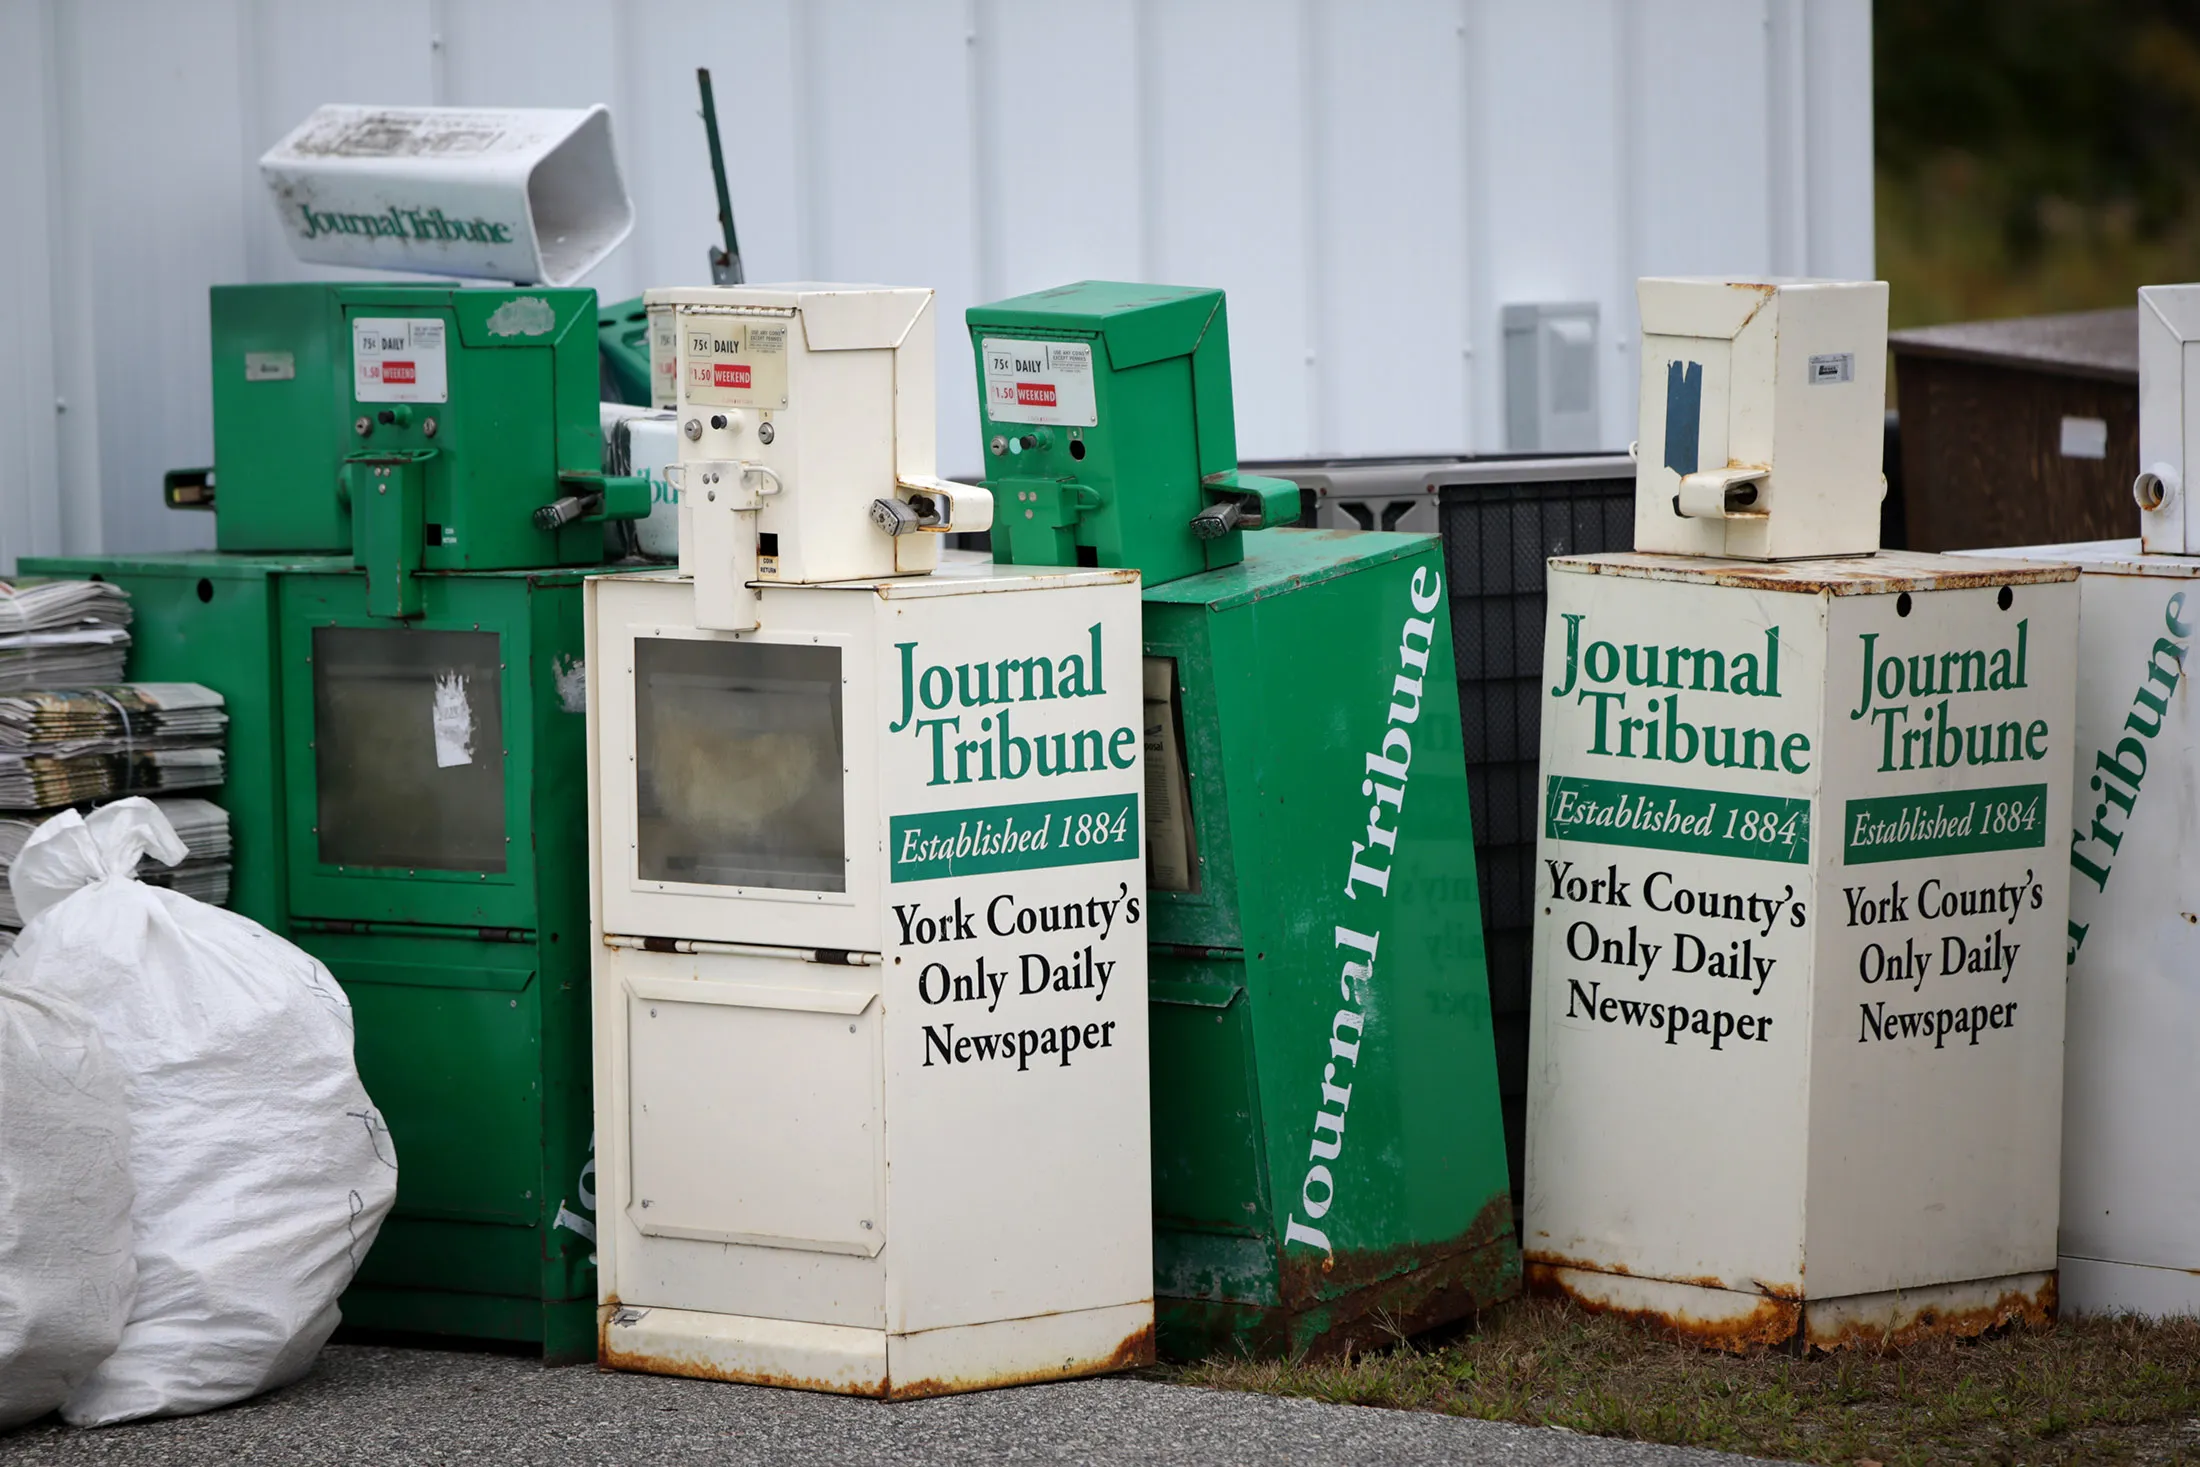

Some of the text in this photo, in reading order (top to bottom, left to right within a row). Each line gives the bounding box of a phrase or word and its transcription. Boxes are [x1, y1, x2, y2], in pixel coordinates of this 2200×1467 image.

[297, 203, 514, 244] Journal Tribune
[381, 337, 405, 351] DAILY
[382, 367, 416, 380] WEEKEND
[693, 339, 708, 351] 75¢
[714, 339, 740, 354] DAILY
[993, 358, 1009, 370] 75¢
[1015, 359, 1042, 373] DAILY
[714, 370, 751, 384] WEEKEND
[1017, 388, 1056, 402] WEEKEND
[890, 623, 1106, 732] Journal
[1552, 614, 1782, 698] Journal
[1852, 618, 2028, 720] Journal
[916, 709, 1135, 785] Tribune
[1578, 690, 1811, 775] Tribune
[1873, 701, 2048, 772] Tribune
[2069, 591, 2196, 894] Tribune
[897, 807, 1128, 865] Established 1884
[1554, 791, 1799, 844] Established 1884
[1851, 797, 2038, 846] Established 1884
[892, 882, 1139, 945] York County's
[1285, 566, 1441, 1262] Journal Tribune
[1545, 860, 1805, 937] York County's
[1843, 869, 2042, 926] York County's
[919, 946, 1115, 1012] Only Daily
[1567, 921, 1776, 995] Only Daily
[1860, 938, 1932, 992] Only
[1940, 929, 2020, 983] Daily
[1566, 979, 1772, 1050] Newspaper
[1859, 1002, 2017, 1049] Newspaper
[922, 1022, 1115, 1071] Newspaper
